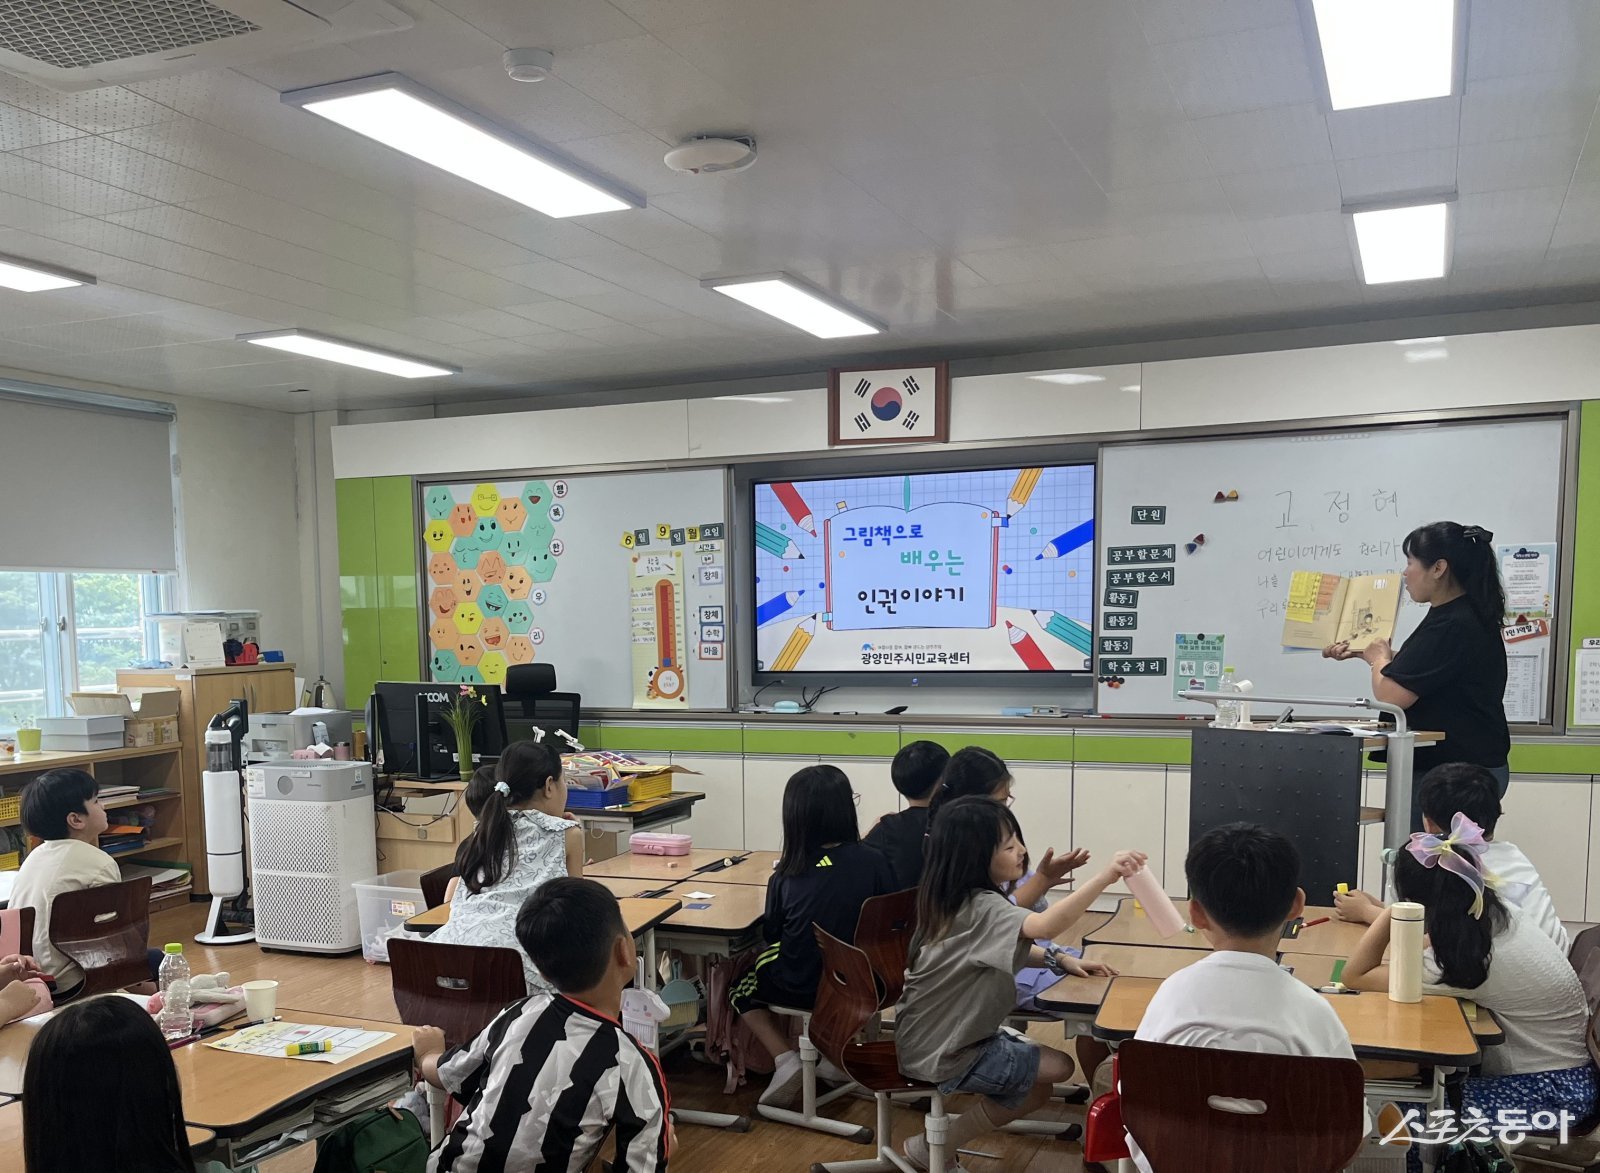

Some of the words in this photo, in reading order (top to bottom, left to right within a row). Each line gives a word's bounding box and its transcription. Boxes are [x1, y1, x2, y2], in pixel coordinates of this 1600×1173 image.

[842, 524, 924, 547] 그림책으로
[900, 550, 965, 577] 배우는
[857, 587, 964, 614] 인권이야기
[706, 628, 720, 638] 수학
[704, 646, 719, 656] 마을
[861, 651, 971, 665] 광양민주시민교육센터
